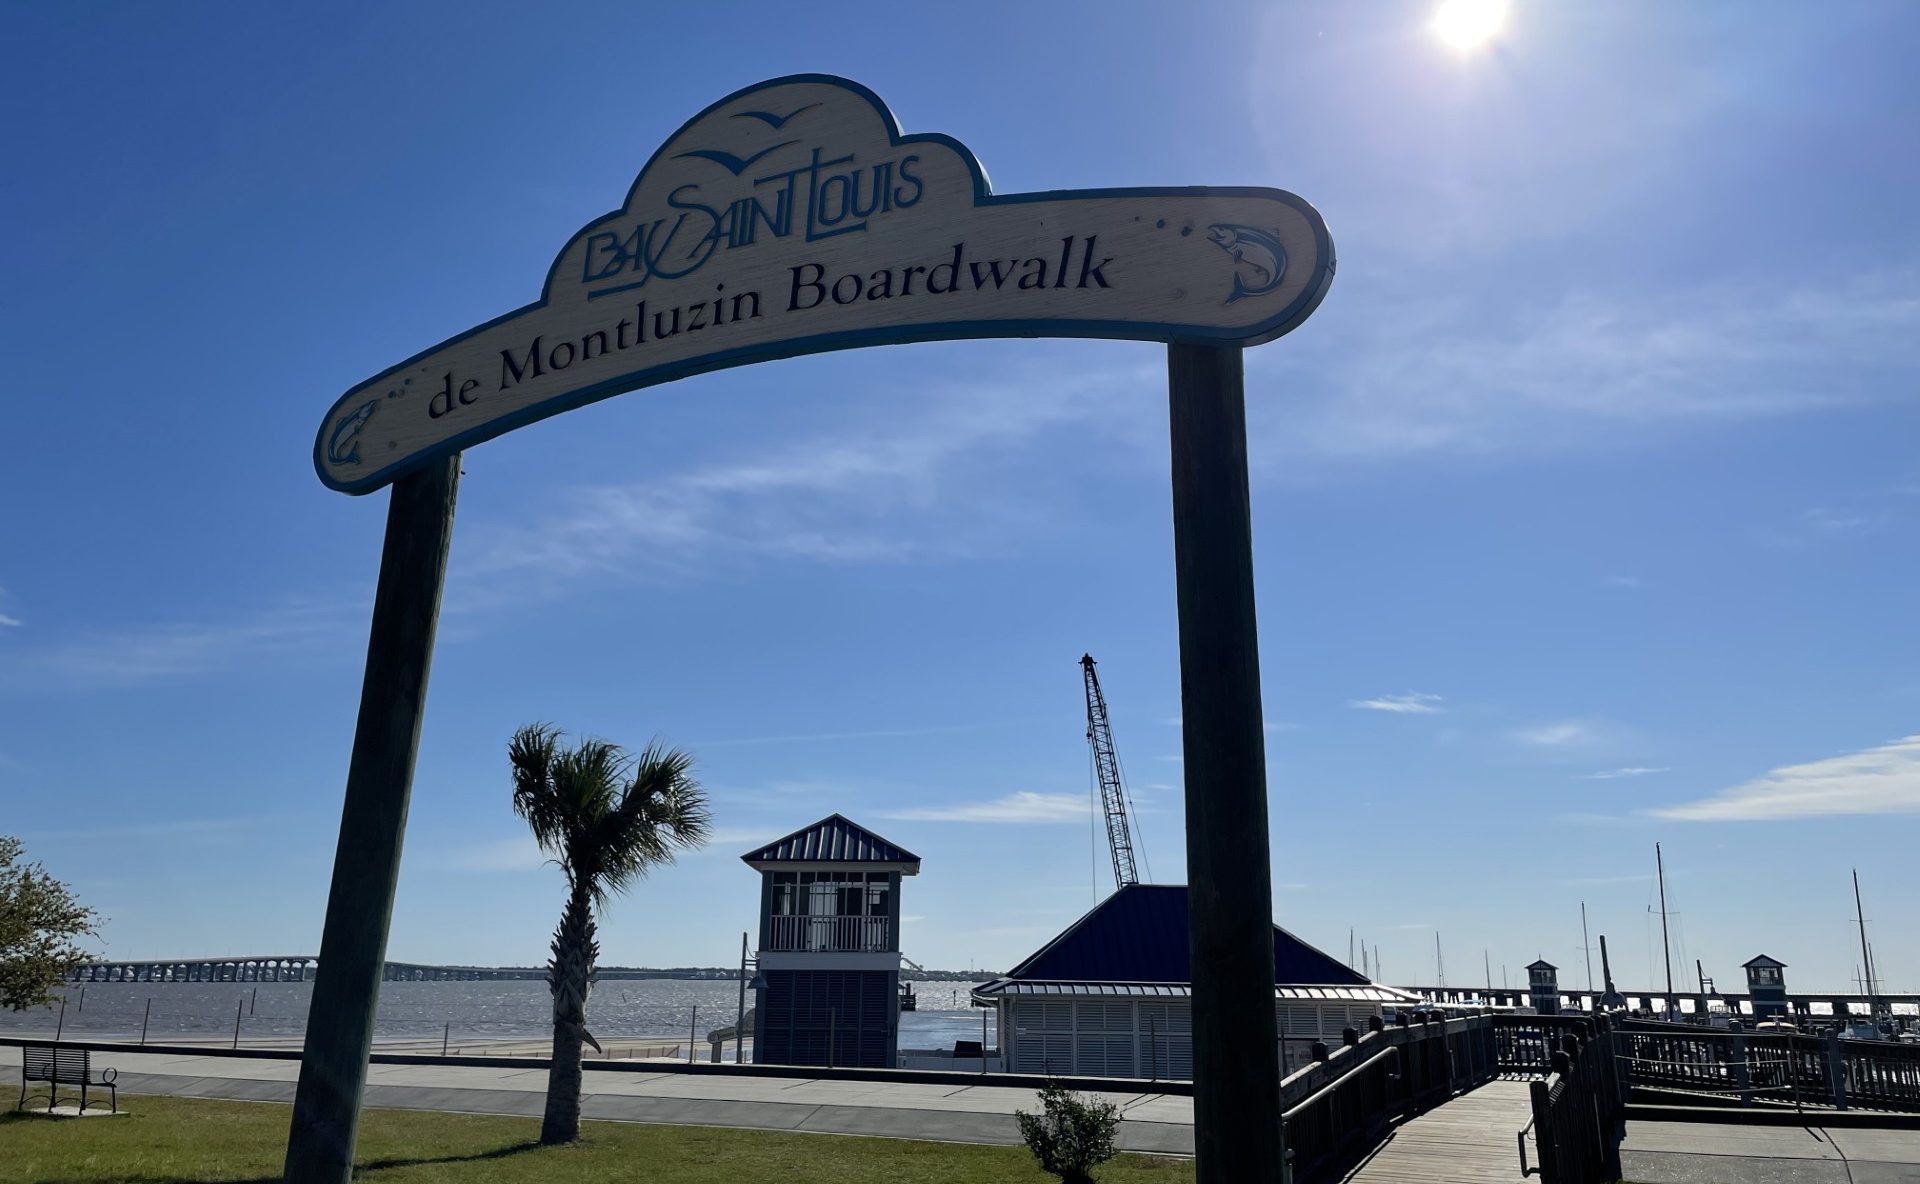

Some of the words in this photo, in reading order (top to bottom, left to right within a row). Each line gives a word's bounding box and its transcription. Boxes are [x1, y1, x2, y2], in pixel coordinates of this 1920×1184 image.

[582, 213, 690, 301] BAY
[655, 158, 826, 279] SAINT
[806, 147, 924, 242] LOUIS
[427, 371, 479, 419] de
[499, 283, 762, 392] Montluzin
[786, 234, 1115, 312] Boardwalk
